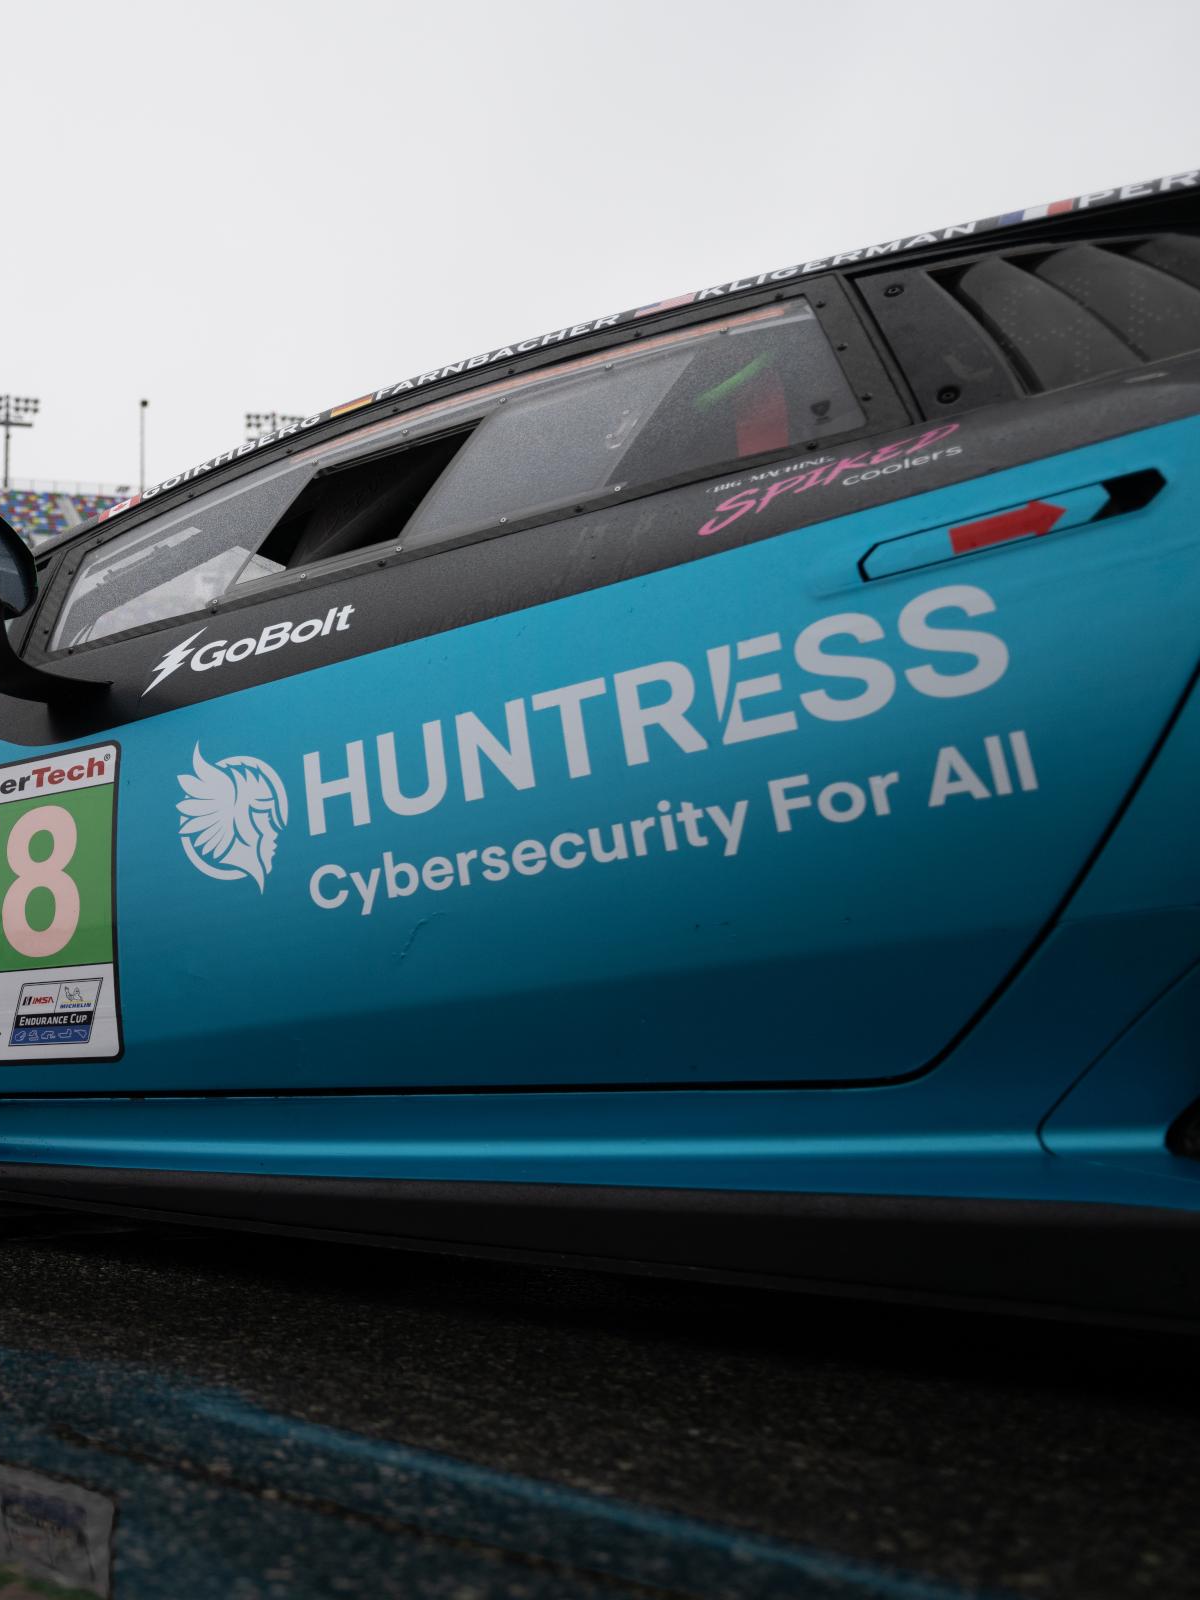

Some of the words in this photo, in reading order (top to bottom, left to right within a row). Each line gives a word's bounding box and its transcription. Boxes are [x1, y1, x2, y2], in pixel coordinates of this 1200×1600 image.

[696, 221, 978, 300] KLIGERMAN
[374, 313, 621, 401] FARNBACHER
[142, 414, 321, 499] GOIKHBERG
[697, 424, 960, 536] SPIKED
[842, 446, 963, 487] coolers
[190, 604, 356, 672] GoBolt
[303, 584, 1010, 837] HUNTRESS
[309, 799, 749, 916] Cybersecurity
[767, 770, 899, 833] For
[928, 730, 1039, 807] All
[19, 1015, 69, 1027] ENDURANCE
[69, 1013, 88, 1024] CUP
[31, 996, 55, 1005] IMSA
